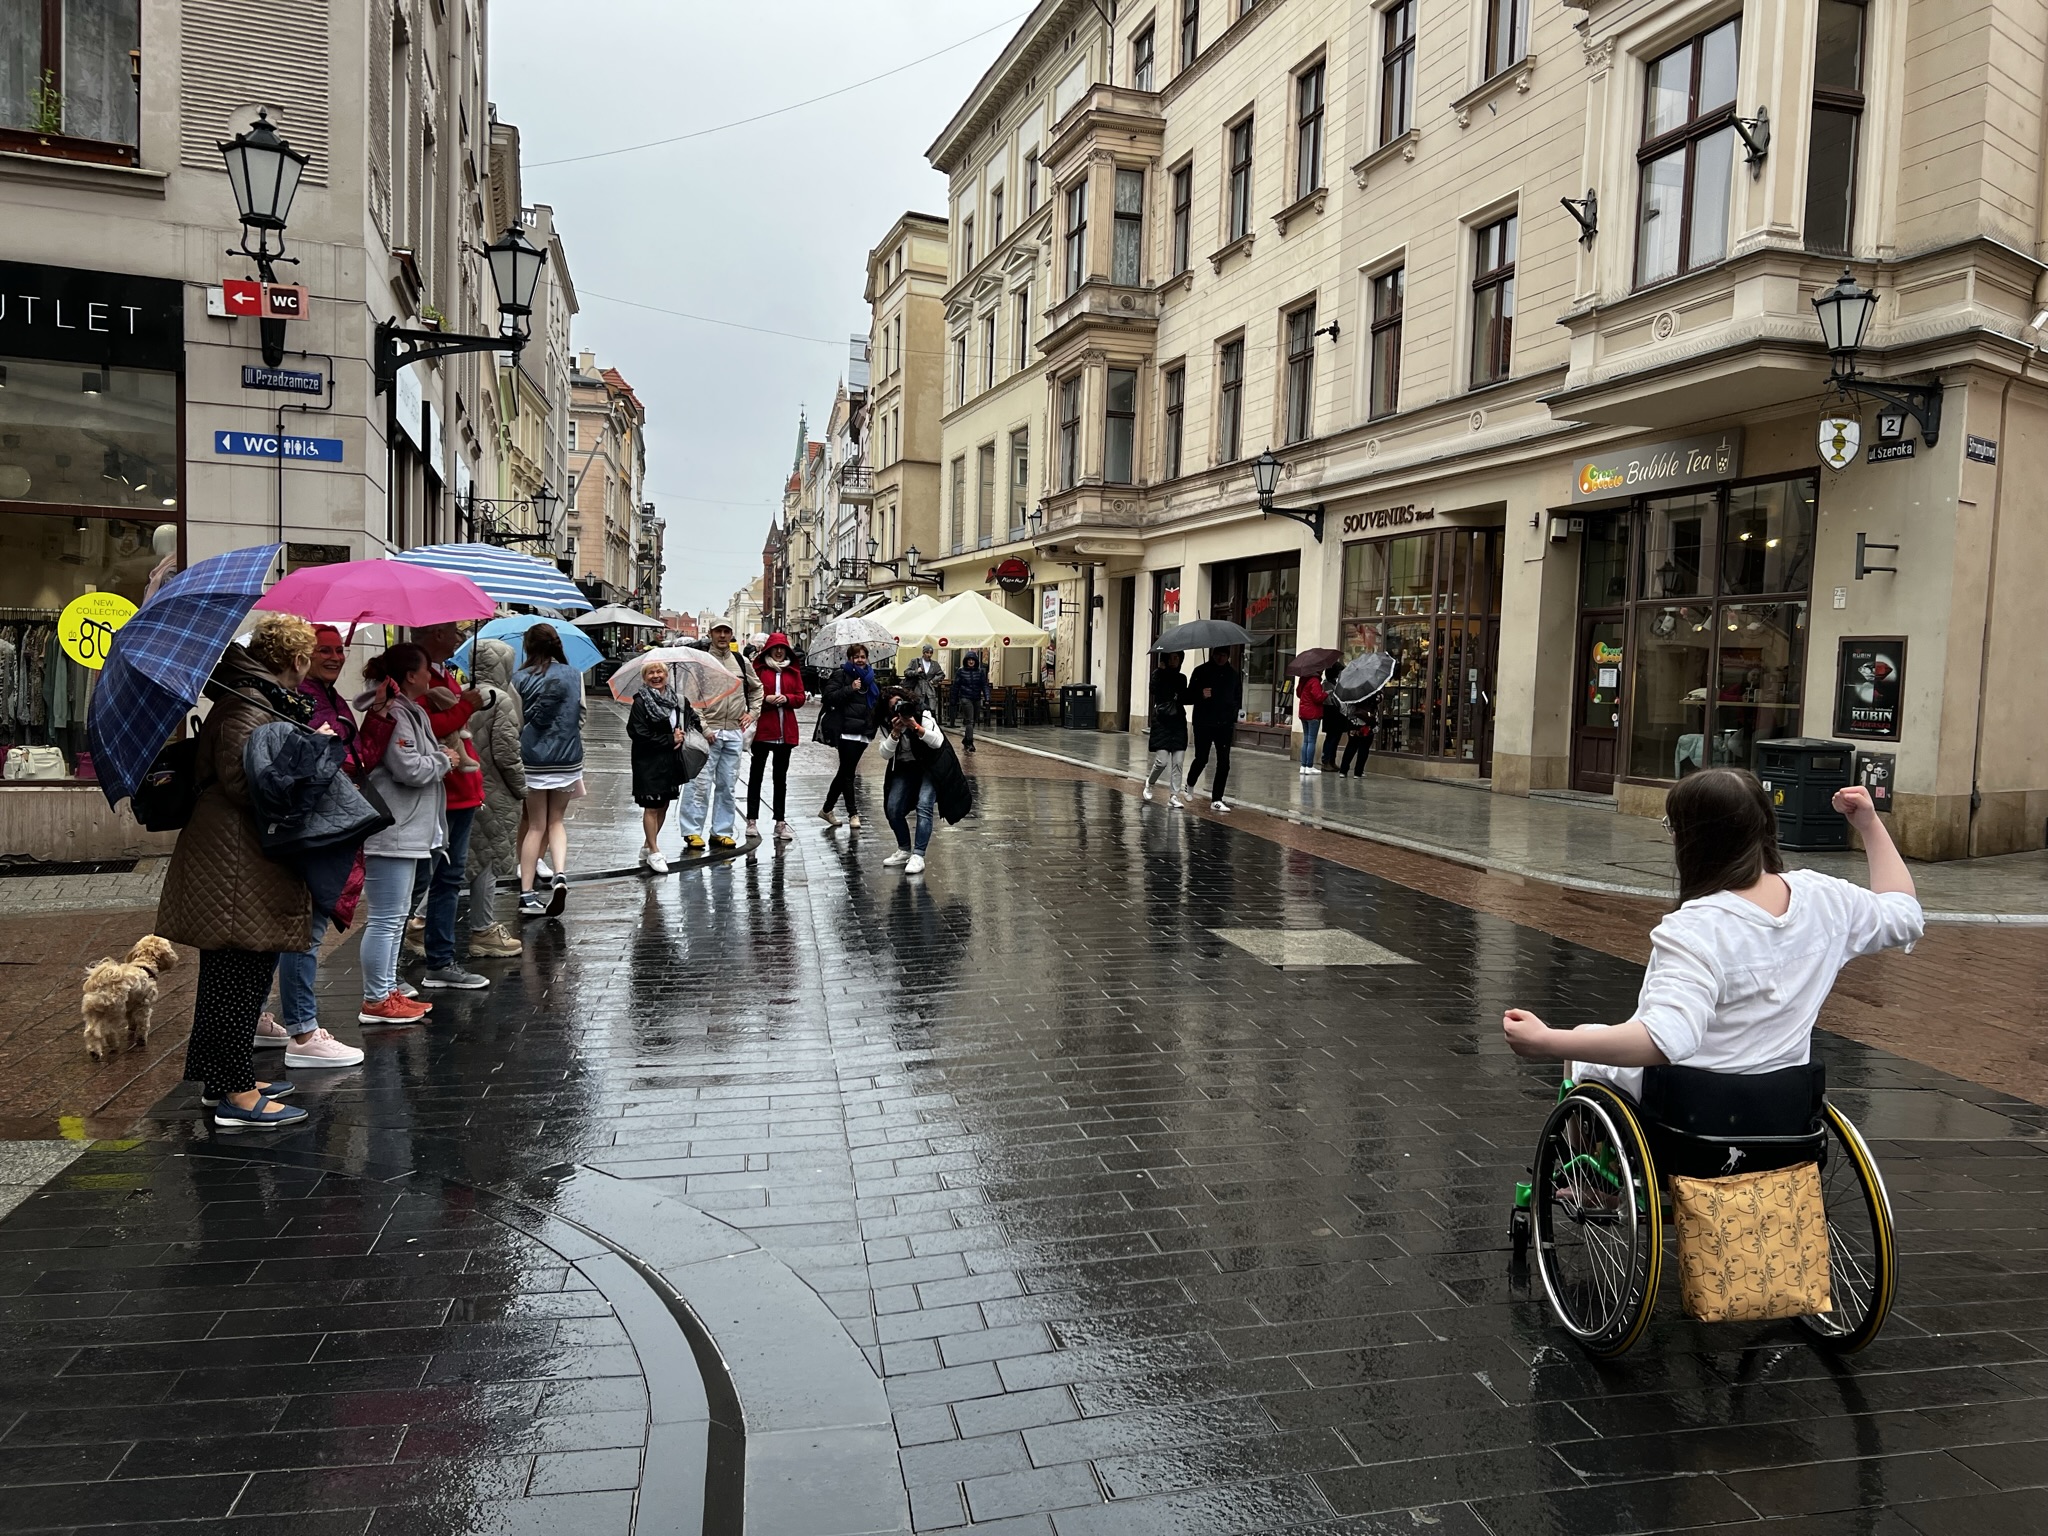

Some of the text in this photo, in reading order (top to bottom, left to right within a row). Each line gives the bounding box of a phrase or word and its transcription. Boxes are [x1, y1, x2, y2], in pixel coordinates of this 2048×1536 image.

[272, 295, 297, 308] WC
[0, 293, 143, 335] TLET
[1886, 419, 1896, 432] 2
[243, 436, 279, 453] WC
[1876, 443, 1913, 459] Szeroka
[1626, 449, 1712, 485] Bubble Tea
[1343, 504, 1415, 534] SOUVENIRS
[93, 599, 114, 607] NEW
[76, 607, 132, 617] COLLECTION
[1852, 710, 1893, 722] RUBIN
